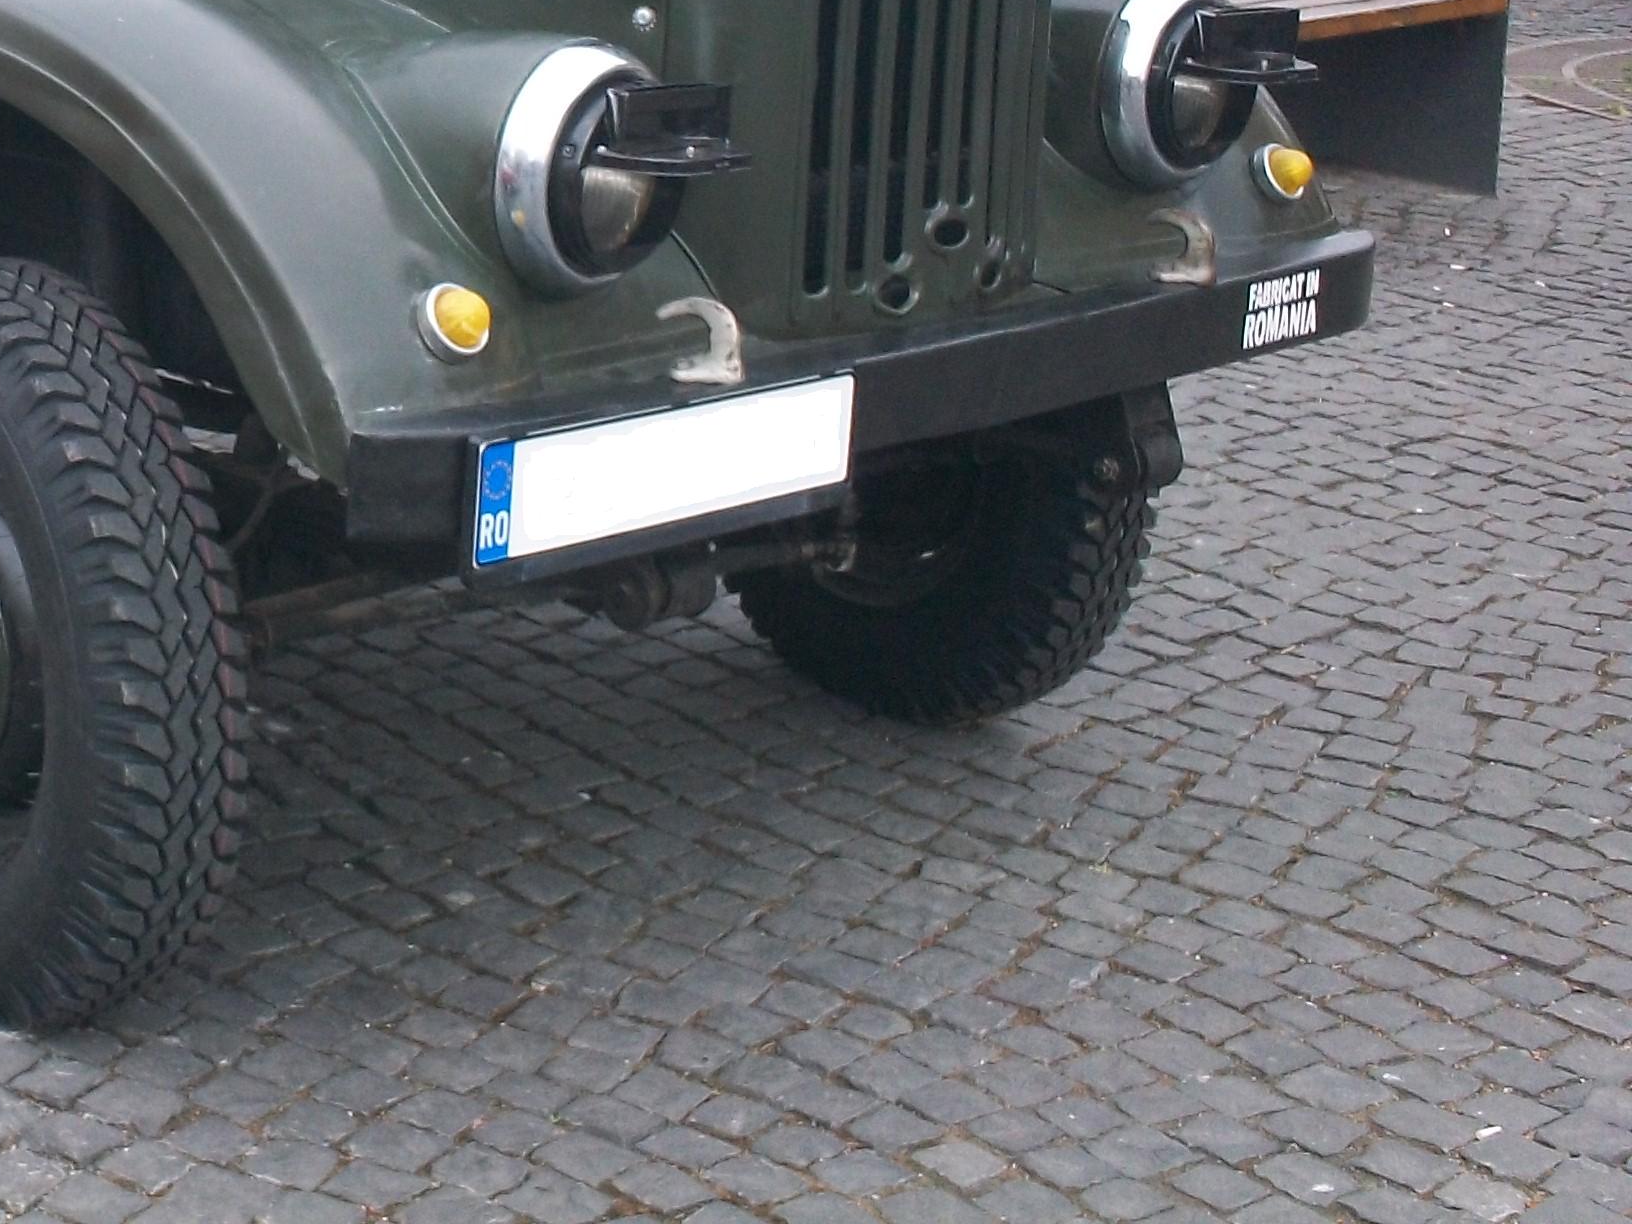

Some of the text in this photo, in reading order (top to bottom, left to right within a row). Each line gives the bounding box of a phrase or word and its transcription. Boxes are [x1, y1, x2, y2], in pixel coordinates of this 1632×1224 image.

[1248, 269, 1320, 312] FABRICAT IN
[1242, 299, 1317, 350] ROMANIA
[479, 509, 509, 550] RO
